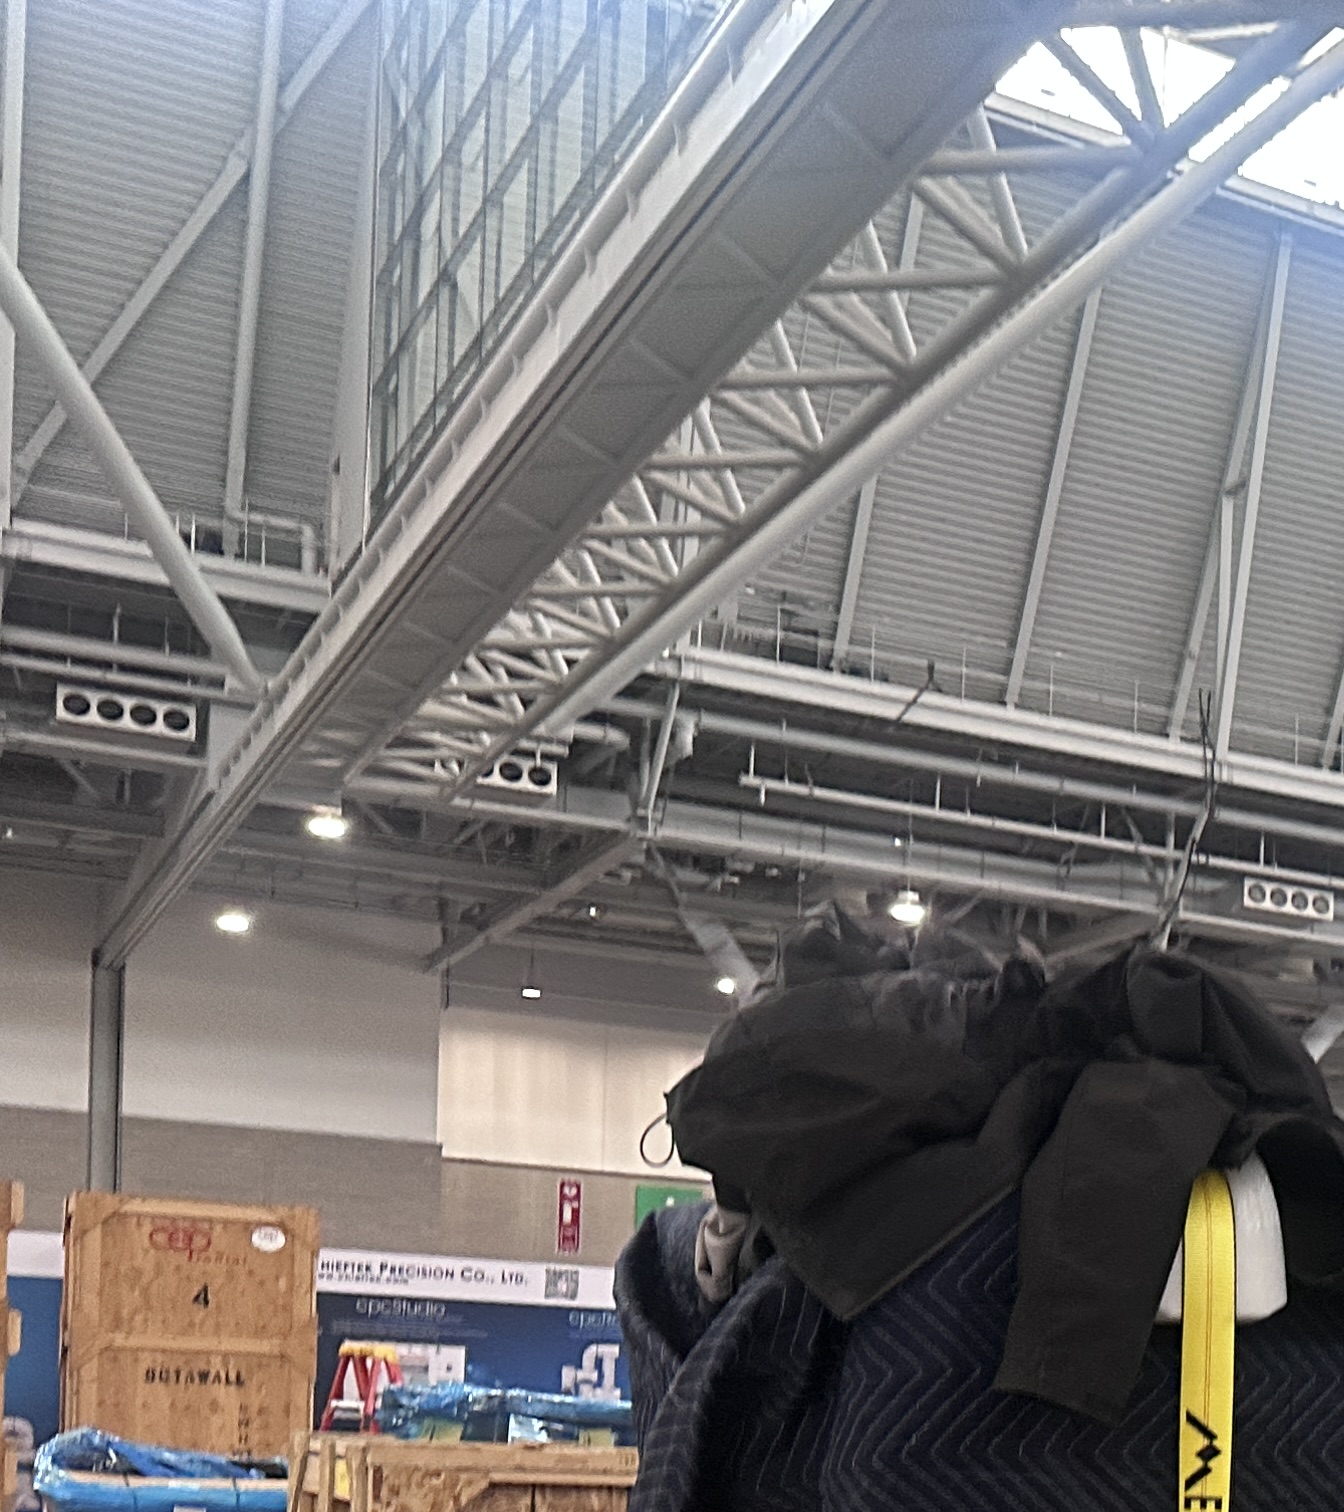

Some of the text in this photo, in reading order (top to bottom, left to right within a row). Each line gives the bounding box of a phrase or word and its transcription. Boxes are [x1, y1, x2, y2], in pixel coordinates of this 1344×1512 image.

[380, 1260, 455, 1281] PRECISION
[501, 1268, 529, 1287] LTD.
[192, 1282, 209, 1309] 4
